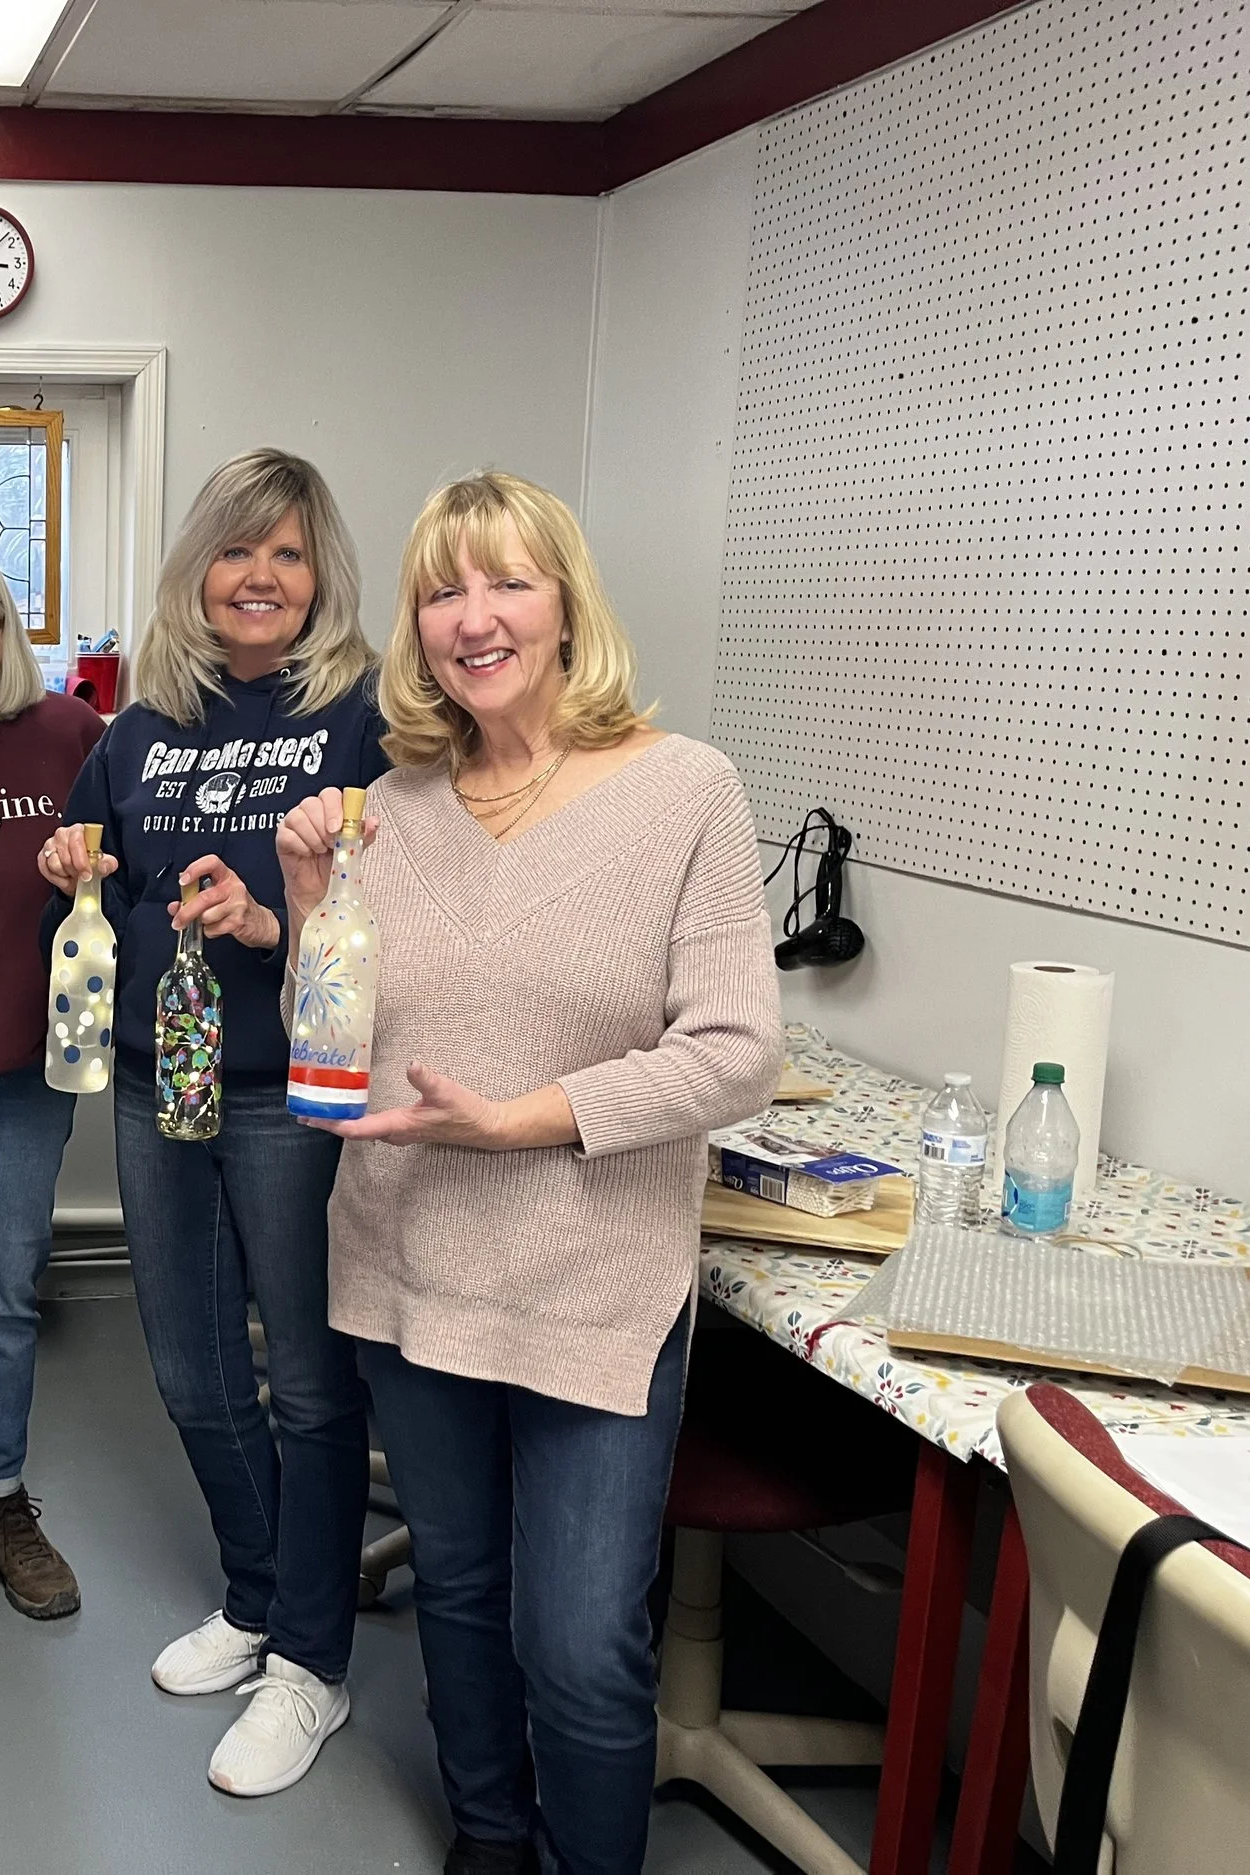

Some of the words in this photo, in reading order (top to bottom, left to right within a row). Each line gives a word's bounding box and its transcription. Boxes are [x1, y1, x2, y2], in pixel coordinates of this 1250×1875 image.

[7, 236, 16, 249] 2
[13, 257, 22, 269] 3
[7, 277, 16, 289] 4
[155, 780, 188, 799] EST
[248, 775, 288, 798] 2003
[291, 1038, 357, 1067] lebrate!
